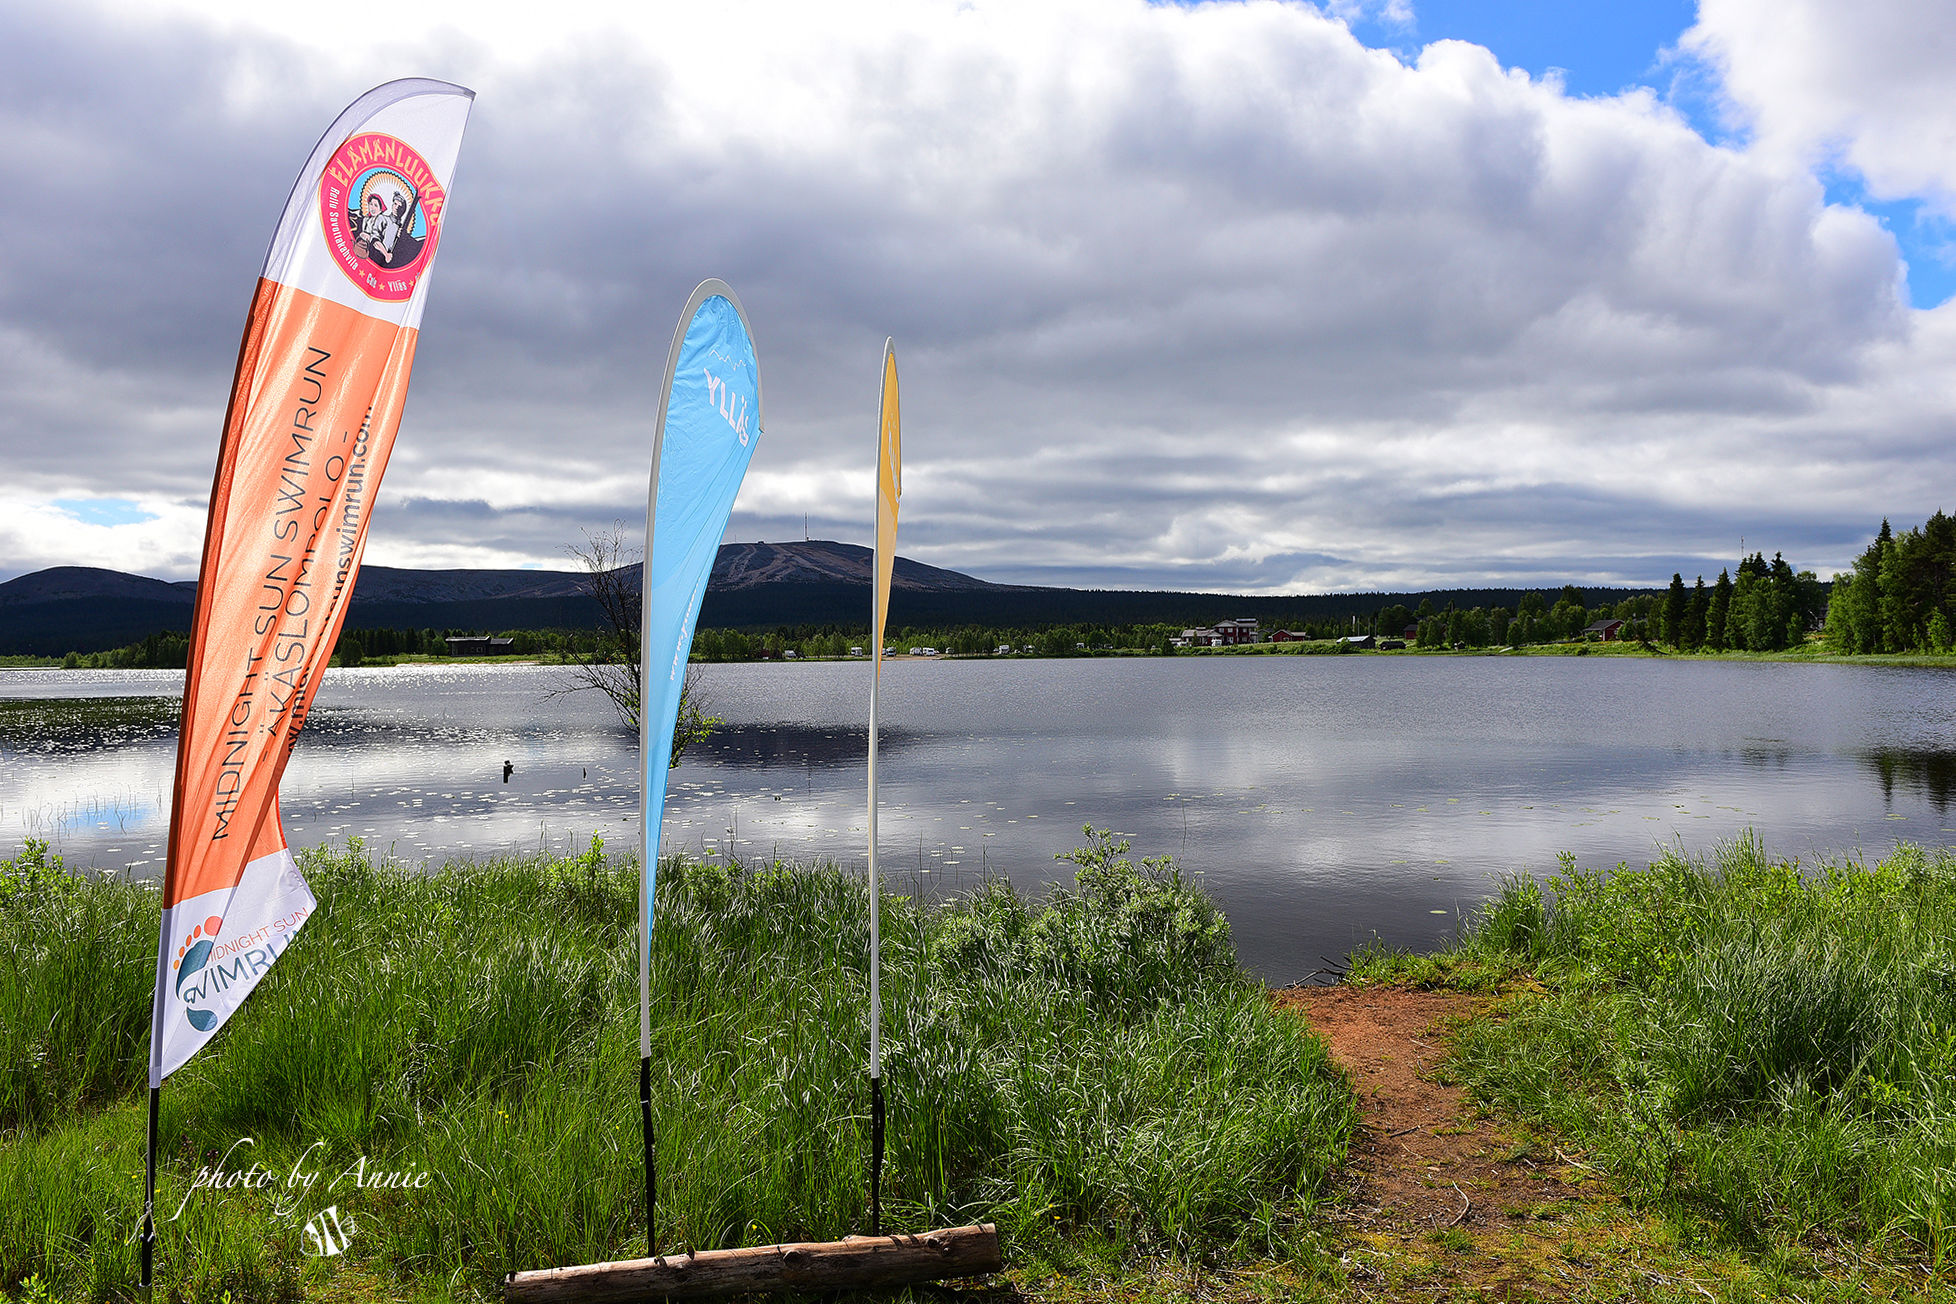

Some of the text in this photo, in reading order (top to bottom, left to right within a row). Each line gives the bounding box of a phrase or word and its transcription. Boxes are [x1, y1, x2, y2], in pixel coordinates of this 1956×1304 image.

[212, 346, 332, 841] MIDNIGHT SUN SWIMRUN
[273, 907, 309, 934] SUN
